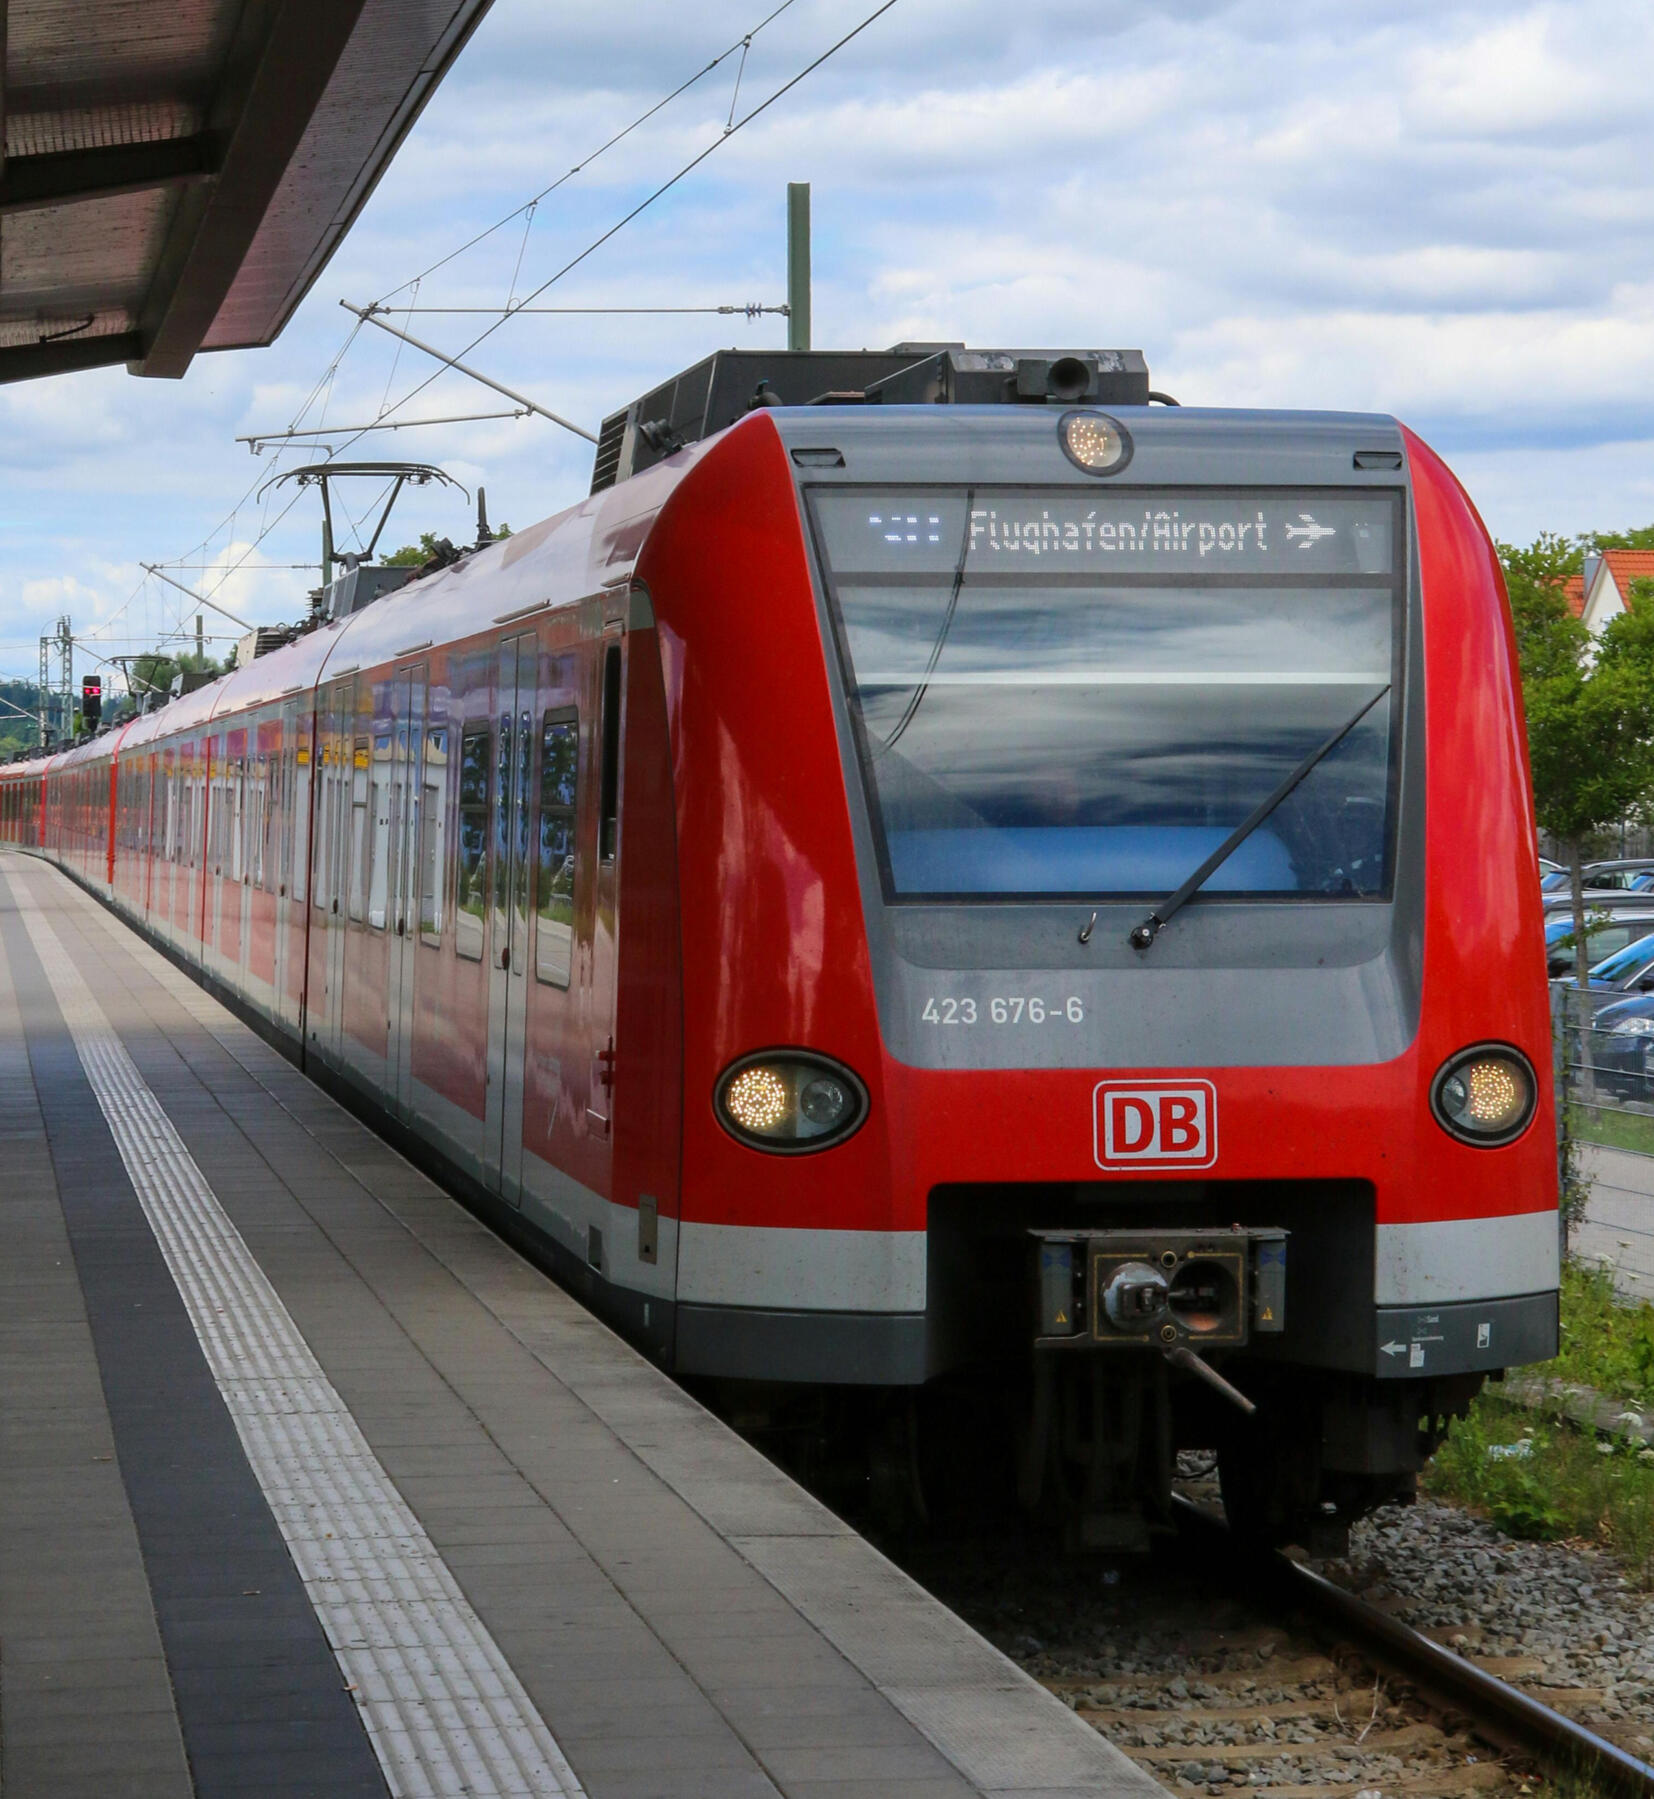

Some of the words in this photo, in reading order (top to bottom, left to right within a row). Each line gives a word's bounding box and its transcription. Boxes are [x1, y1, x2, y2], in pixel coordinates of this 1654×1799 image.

[970, 511, 1268, 557] Flughafen/Airport
[921, 997, 978, 1024] 423
[990, 996, 1084, 1024] 676-6
[1112, 1096, 1201, 1153] DB
